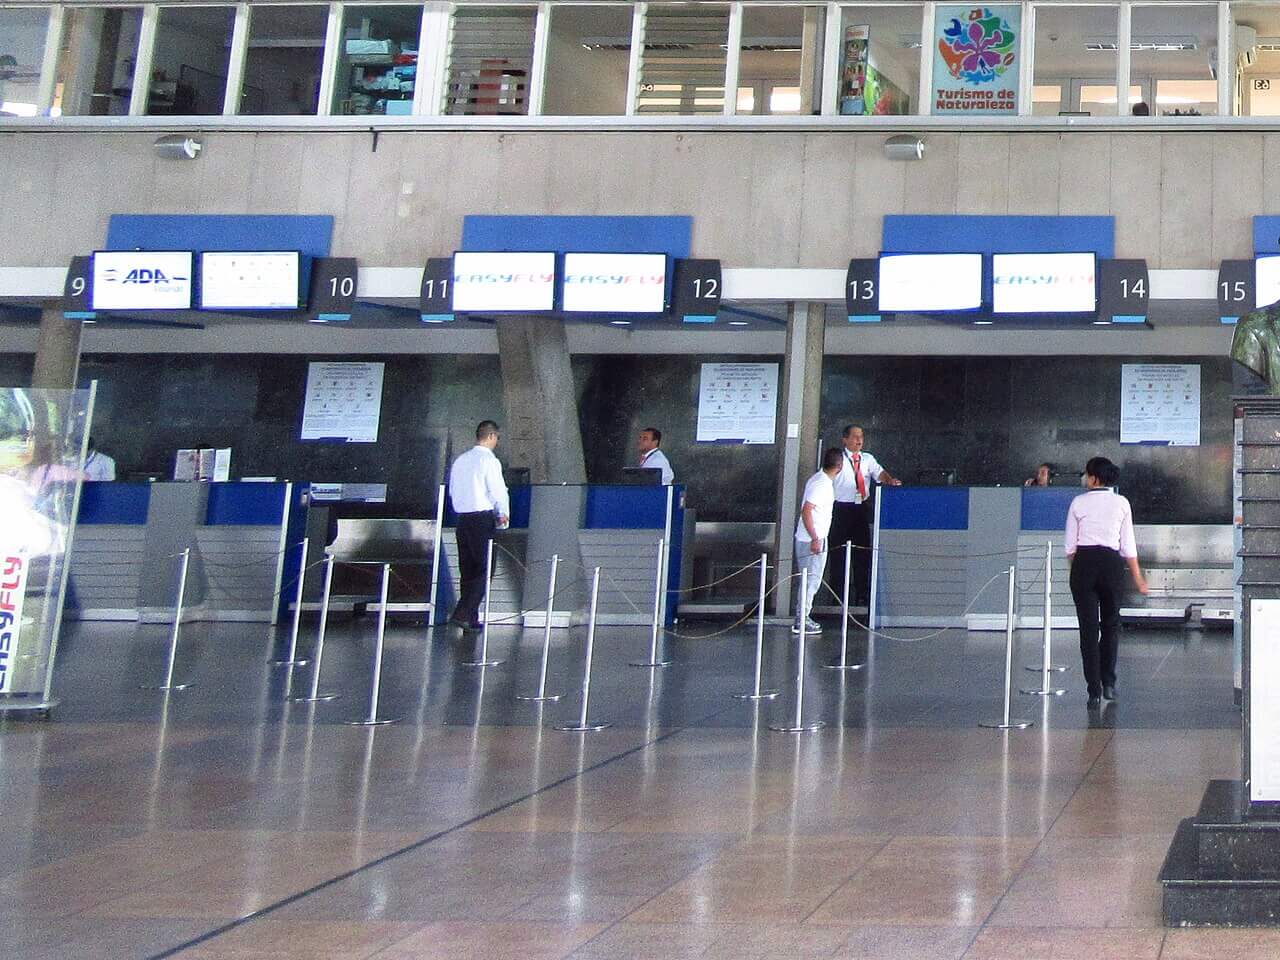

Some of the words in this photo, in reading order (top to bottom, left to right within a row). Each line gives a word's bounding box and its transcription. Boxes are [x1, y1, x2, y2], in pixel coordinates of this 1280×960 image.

[937, 88, 993, 99] Turismo
[997, 89, 1015, 99] de
[936, 100, 1015, 110] Naturaleza
[122, 269, 169, 284] ADA
[454, 273, 555, 284] EASYFLY
[564, 274, 665, 285] EASYFLY
[71, 277, 85, 296] 9
[329, 277, 354, 297] 10
[425, 279, 448, 298] 11
[692, 279, 718, 298] 12
[849, 280, 874, 300] 13
[1119, 279, 1146, 298] 14
[1220, 281, 1246, 301] 15
